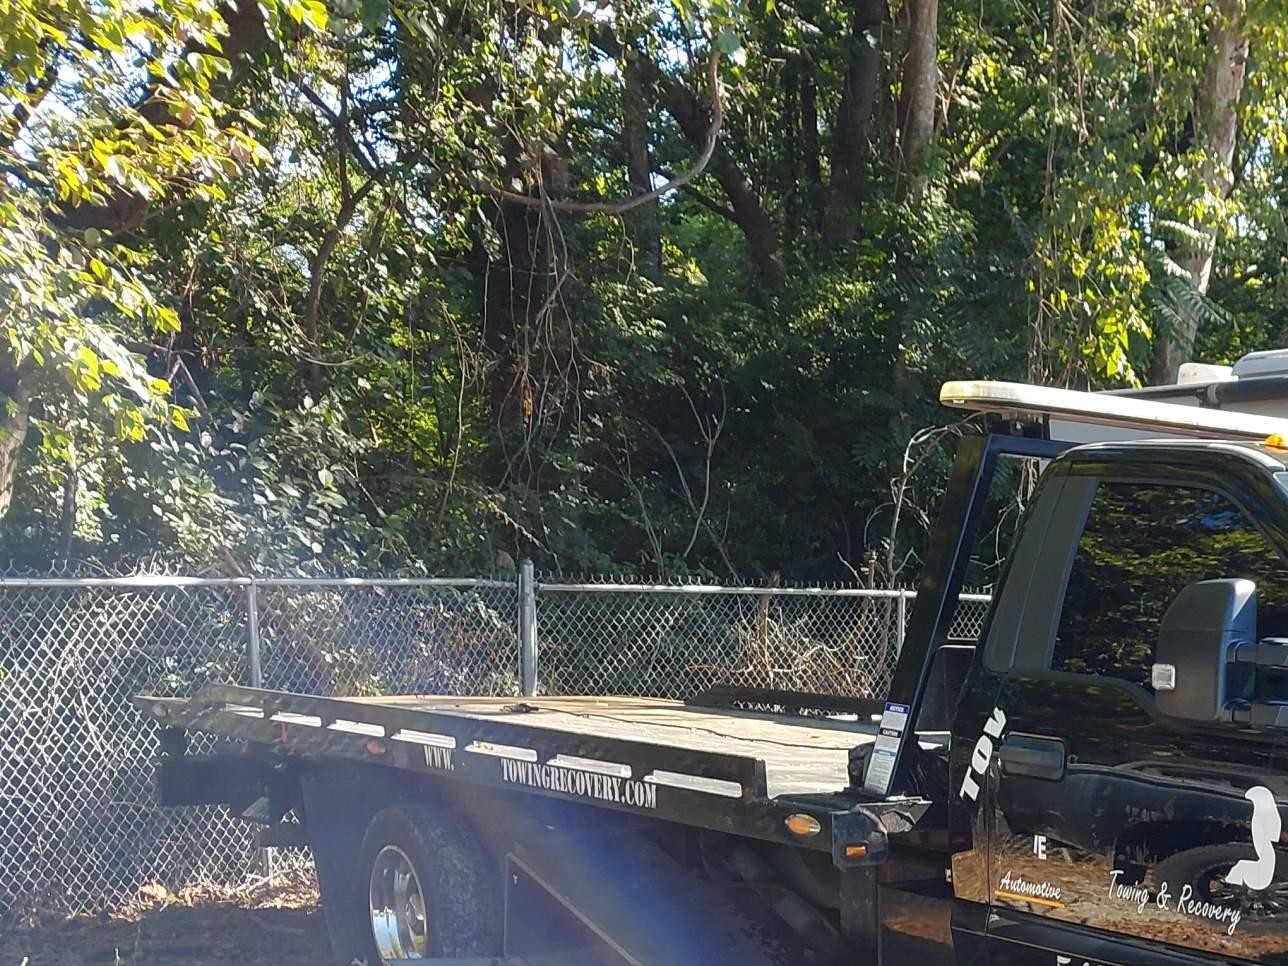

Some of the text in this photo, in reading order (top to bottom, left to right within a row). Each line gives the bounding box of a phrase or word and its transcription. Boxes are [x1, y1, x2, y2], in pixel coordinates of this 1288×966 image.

[501, 757, 657, 809] TOWINGRECOVERY.COM
[1000, 871, 1062, 900] Automotive
[1108, 869, 1241, 936] Towing & Recovery
